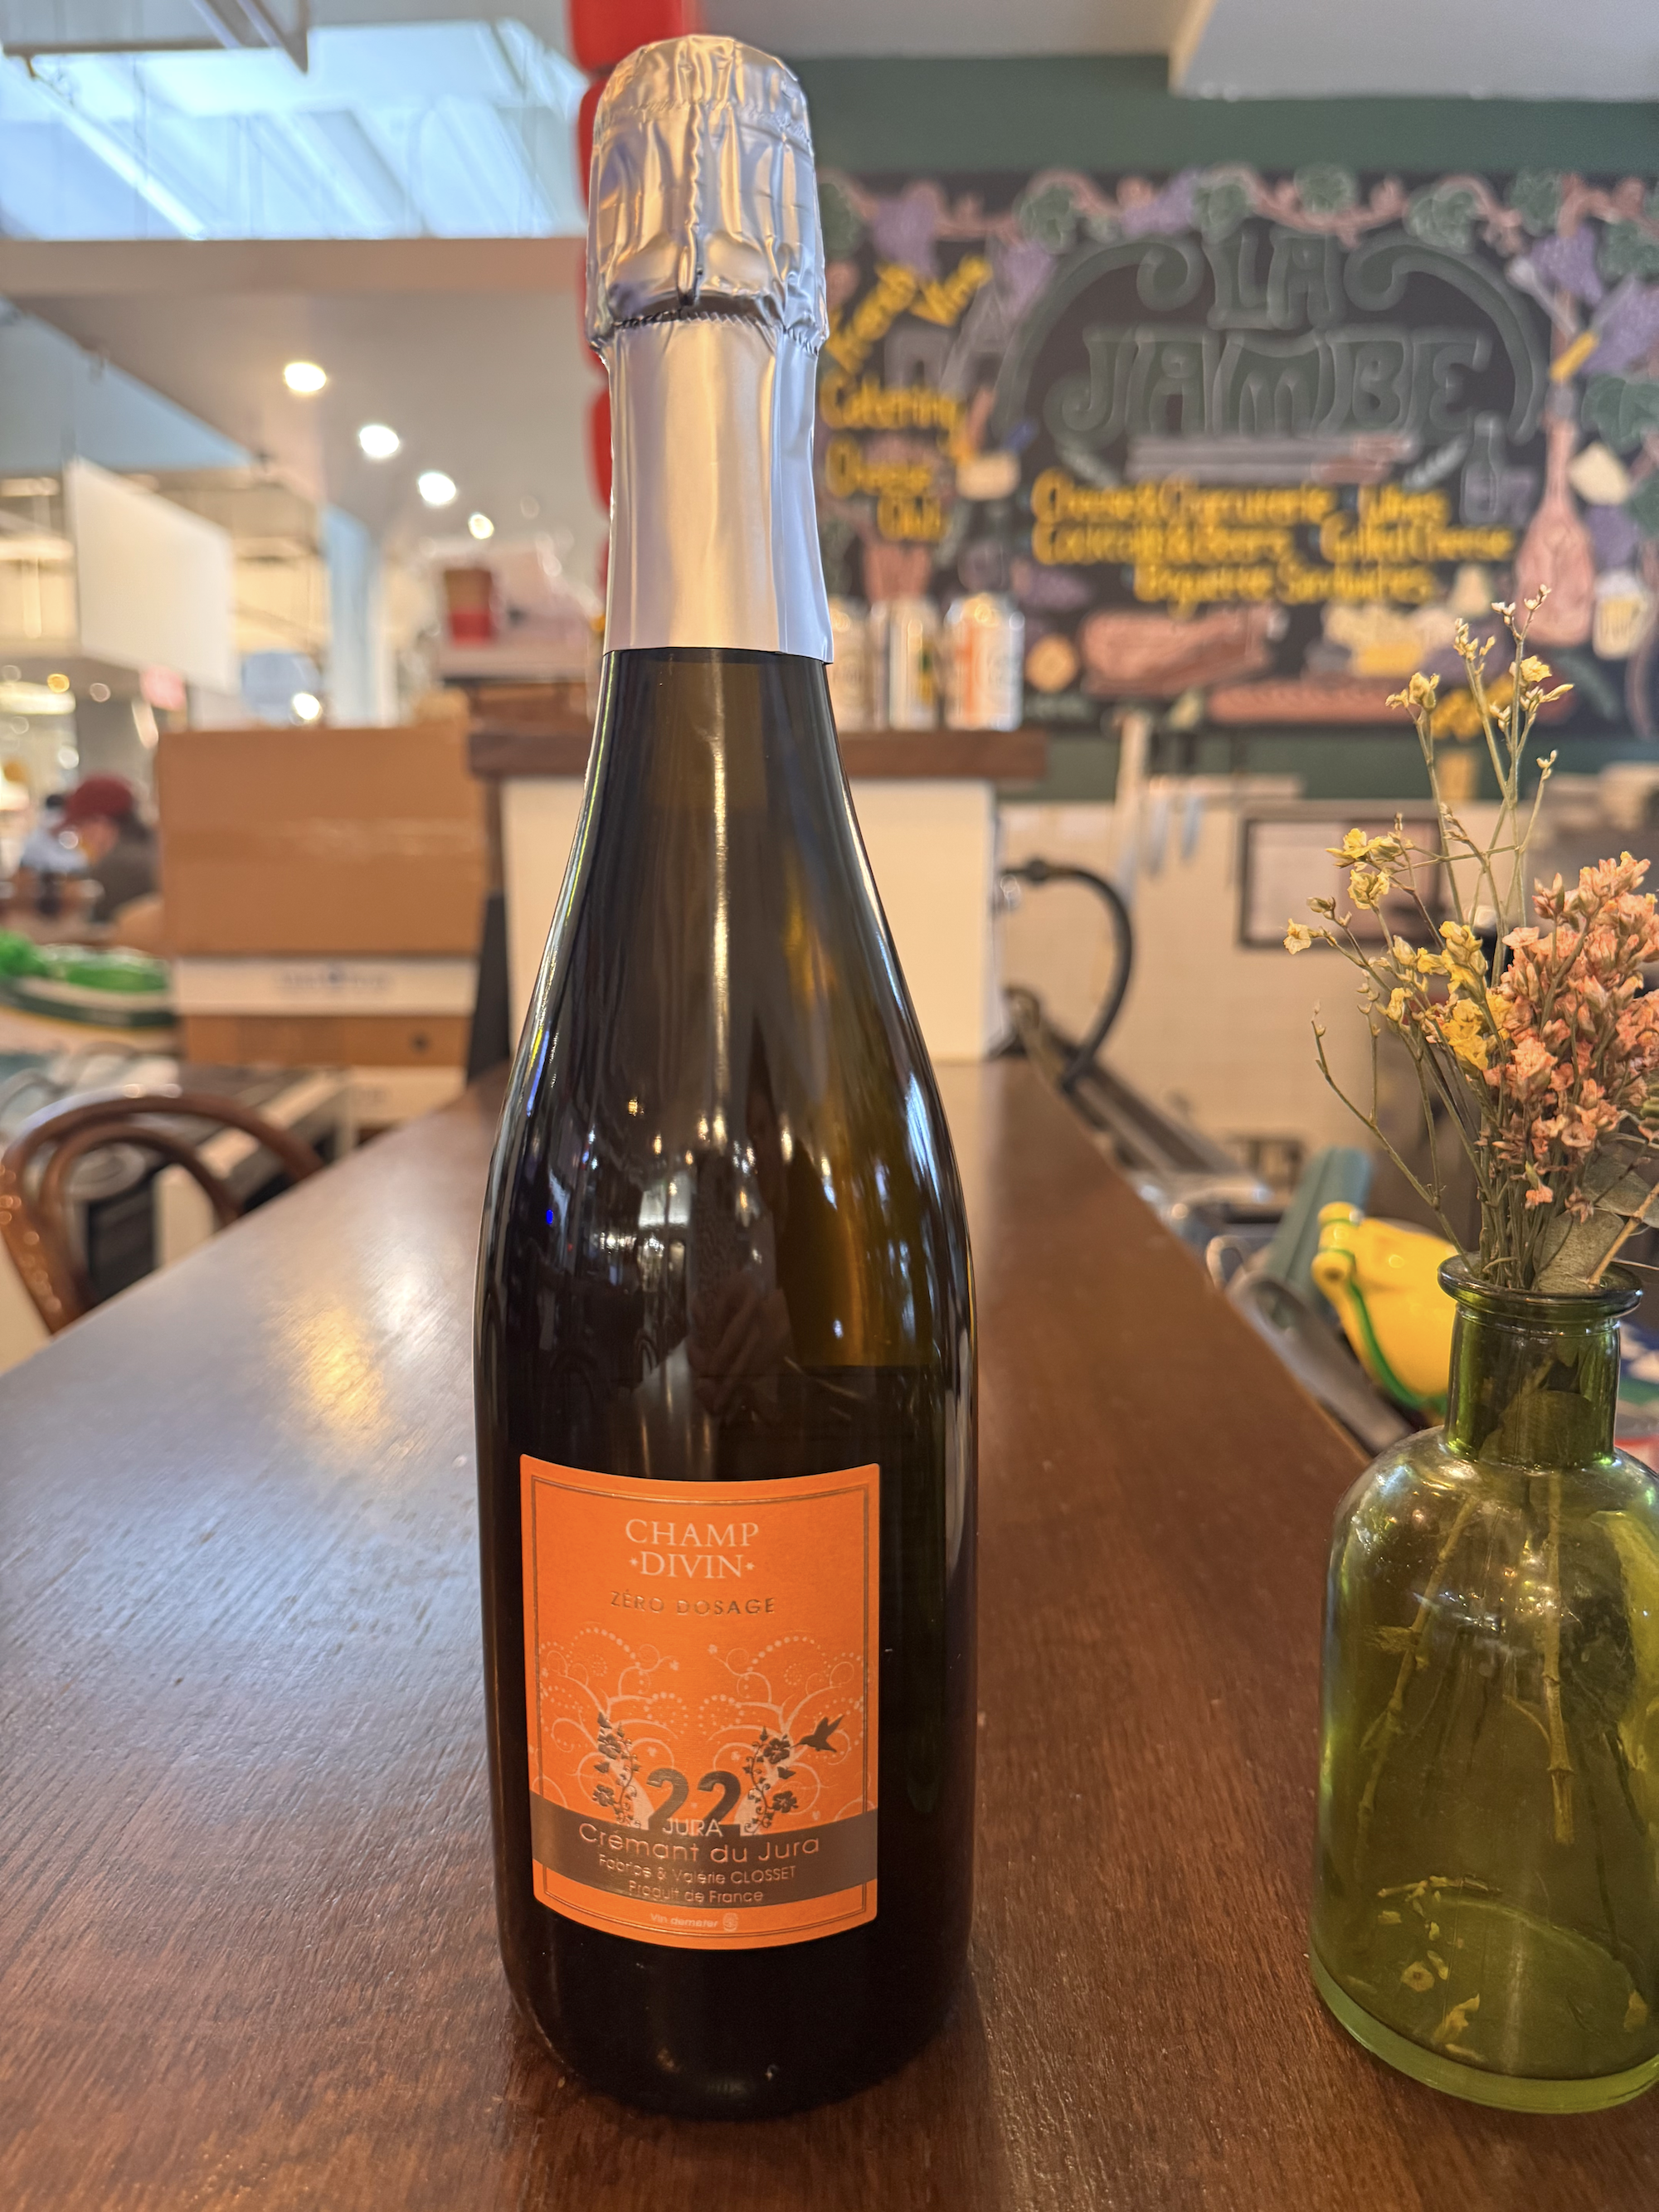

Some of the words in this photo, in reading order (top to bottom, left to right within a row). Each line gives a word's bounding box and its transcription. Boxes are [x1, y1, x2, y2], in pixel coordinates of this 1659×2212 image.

[1203, 227, 1345, 330] LA
[1044, 323, 1491, 440] JAMBE
[625, 1518, 759, 1548] CHAMP
[610, 1587, 664, 1613] ZÉRO
[677, 1597, 776, 1616] DOSAGE
[645, 1767, 742, 1831] 22
[662, 1817, 723, 1837] JURA
[579, 1822, 699, 1863] Crémant
[710, 1844, 747, 1863] du
[758, 1837, 820, 1861] Jura
[599, 1853, 652, 1879] Fabrice
[657, 1866, 667, 1881] &
[730, 1865, 796, 1884] CLOSSET
[629, 1879, 679, 1901] Produit
[684, 1889, 704, 1903] de
[709, 1890, 764, 1903] France
[650, 1912, 668, 1924] Vin
